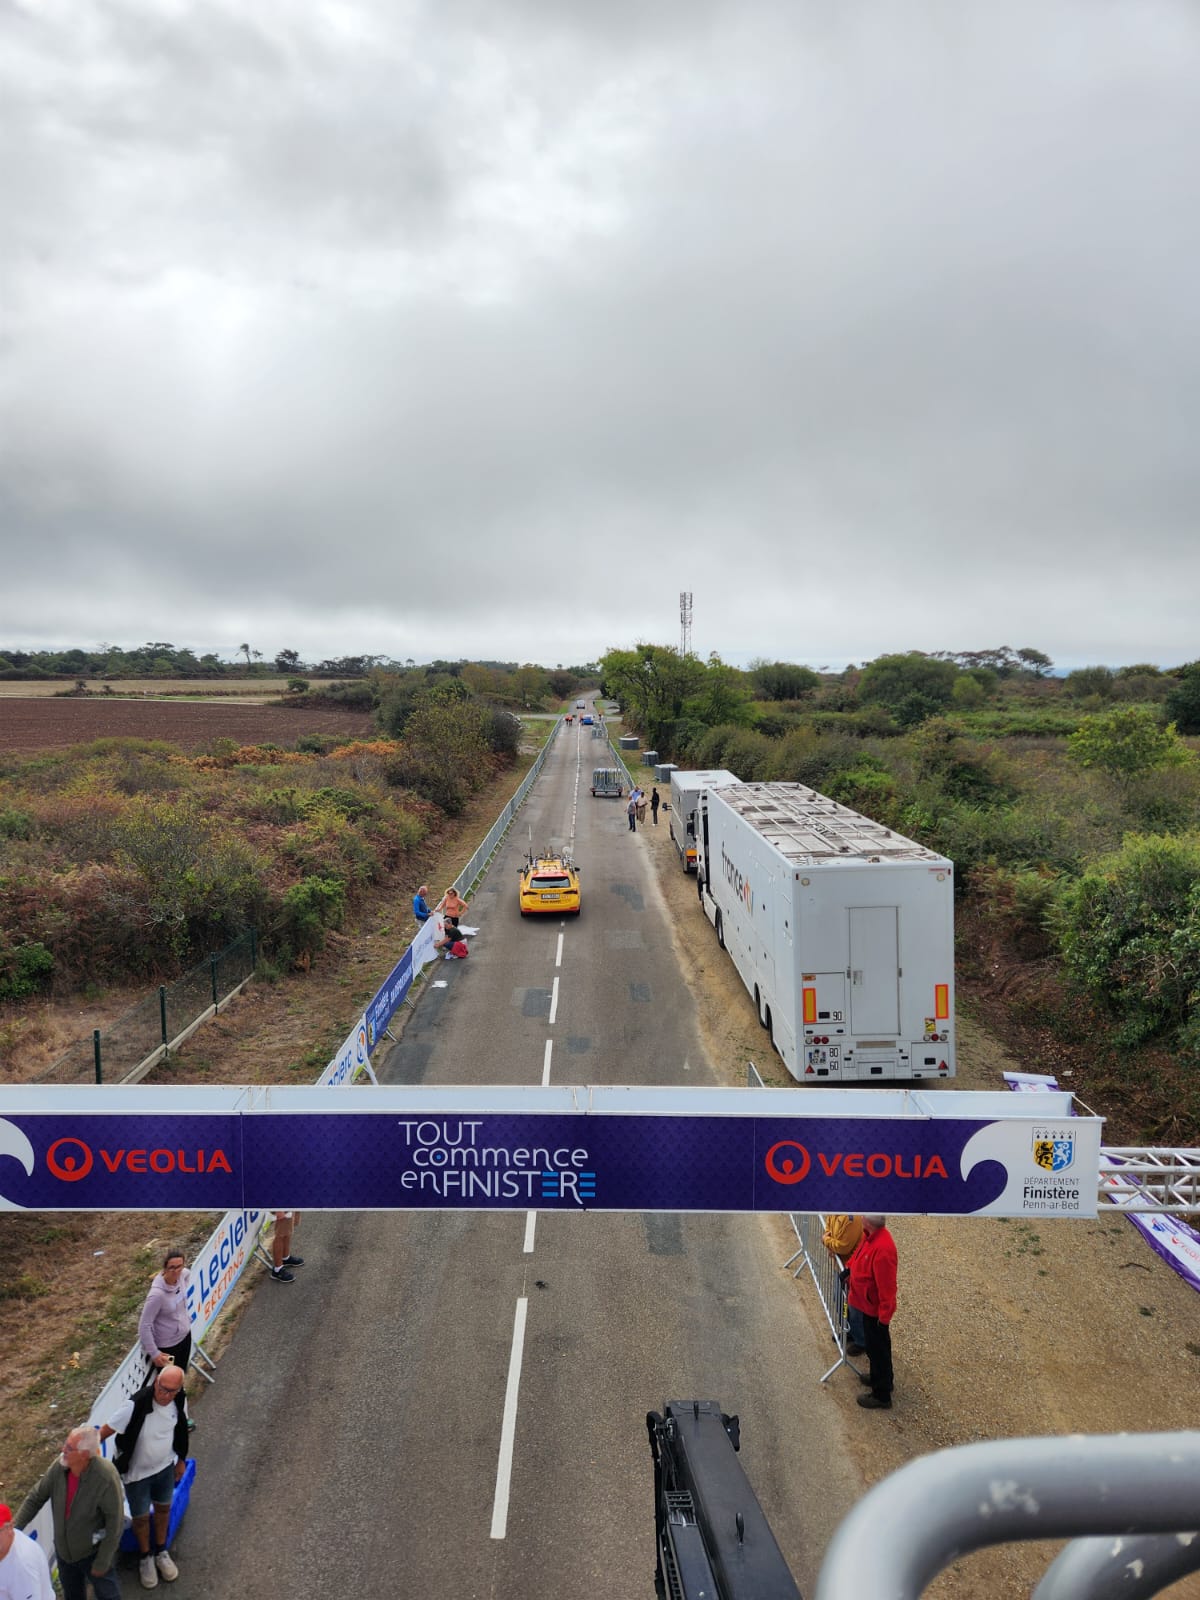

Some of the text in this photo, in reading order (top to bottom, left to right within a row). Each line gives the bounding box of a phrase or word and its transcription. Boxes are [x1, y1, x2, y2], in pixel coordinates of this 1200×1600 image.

[833, 1011, 842, 1021] 90
[829, 1047, 839, 1057] 80
[829, 1061, 839, 1070] 60
[398, 1121, 483, 1145] TOUT
[99, 1149, 232, 1173] VEOLIA
[413, 1148, 588, 1171] commence
[818, 1153, 949, 1178] VEOLIA
[400, 1171, 441, 1194] en
[1024, 1177, 1080, 1185] DÉPARTEMENT
[1023, 1186, 1080, 1199] Finistère
[1023, 1200, 1080, 1210] Penn-ar-Bed
